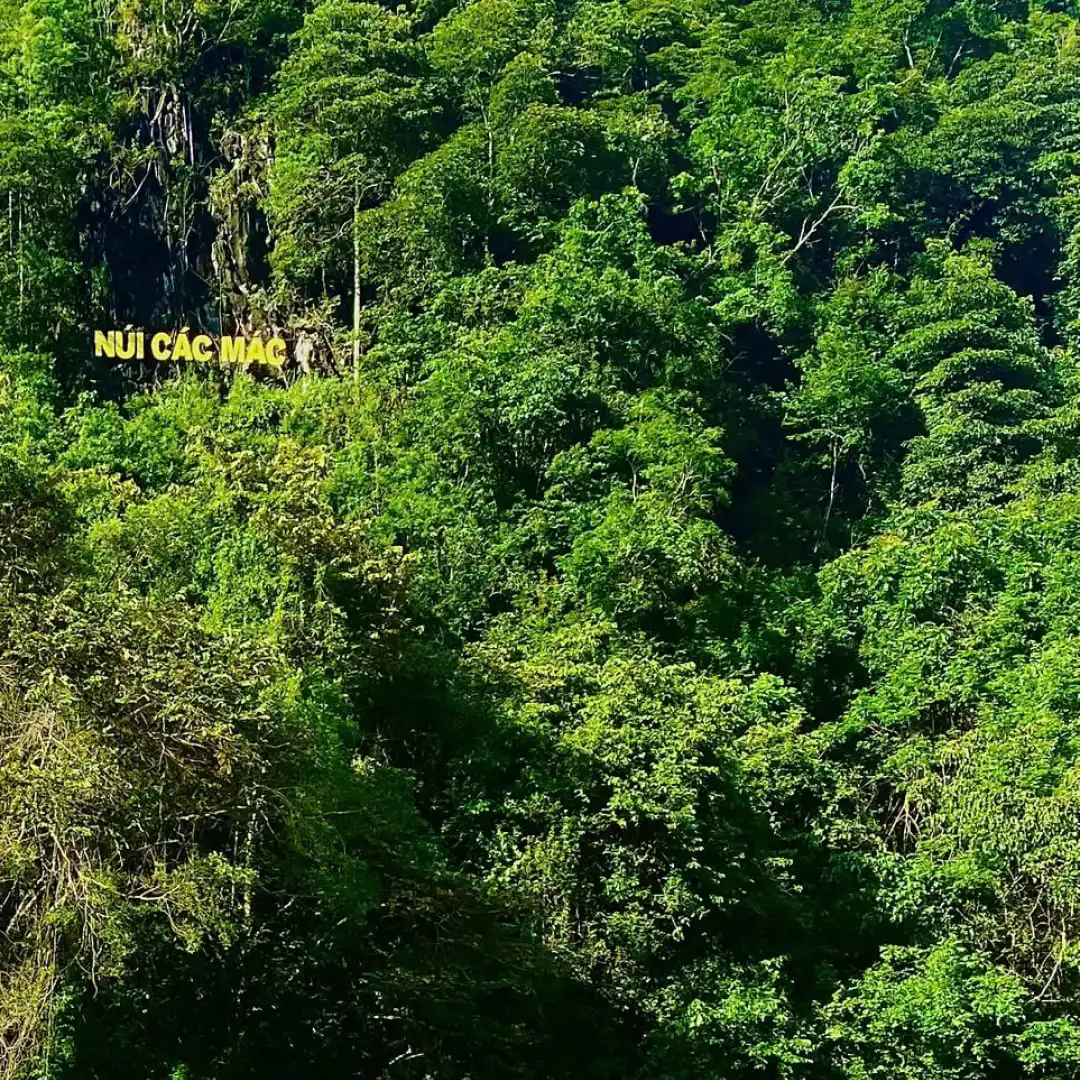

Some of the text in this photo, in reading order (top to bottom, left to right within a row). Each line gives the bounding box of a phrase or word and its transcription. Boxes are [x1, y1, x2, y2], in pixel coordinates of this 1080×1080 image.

[94, 324, 287, 366] NÚI CÁC MÁC
